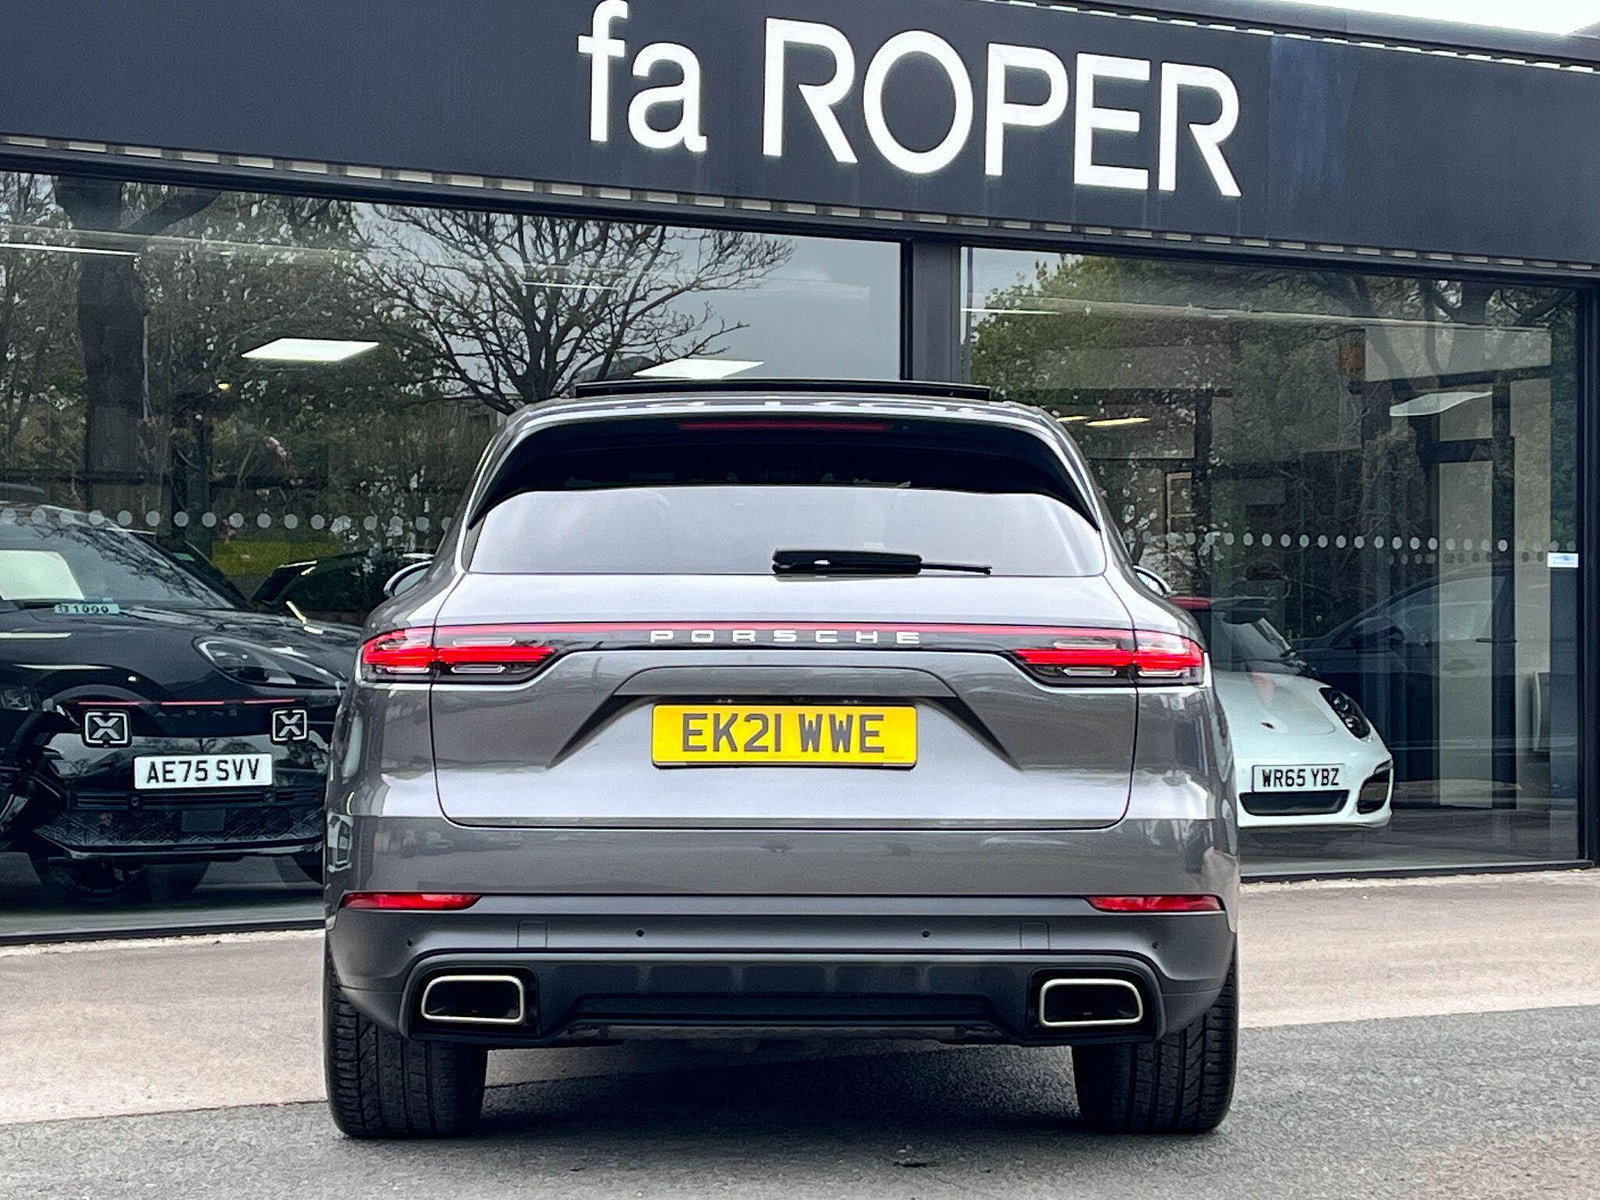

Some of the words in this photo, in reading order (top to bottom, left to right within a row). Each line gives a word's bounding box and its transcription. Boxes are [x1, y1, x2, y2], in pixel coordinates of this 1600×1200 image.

[577, 0, 707, 153] fa
[762, 17, 1242, 197] ROPER
[649, 629, 921, 646] PORSCHE
[681, 712, 782, 753] EK21
[799, 713, 885, 753] WWE
[146, 759, 209, 784] AE75
[216, 757, 260, 781] SVV
[1262, 768, 1305, 788] WR65
[1311, 767, 1340, 787] YBZ
